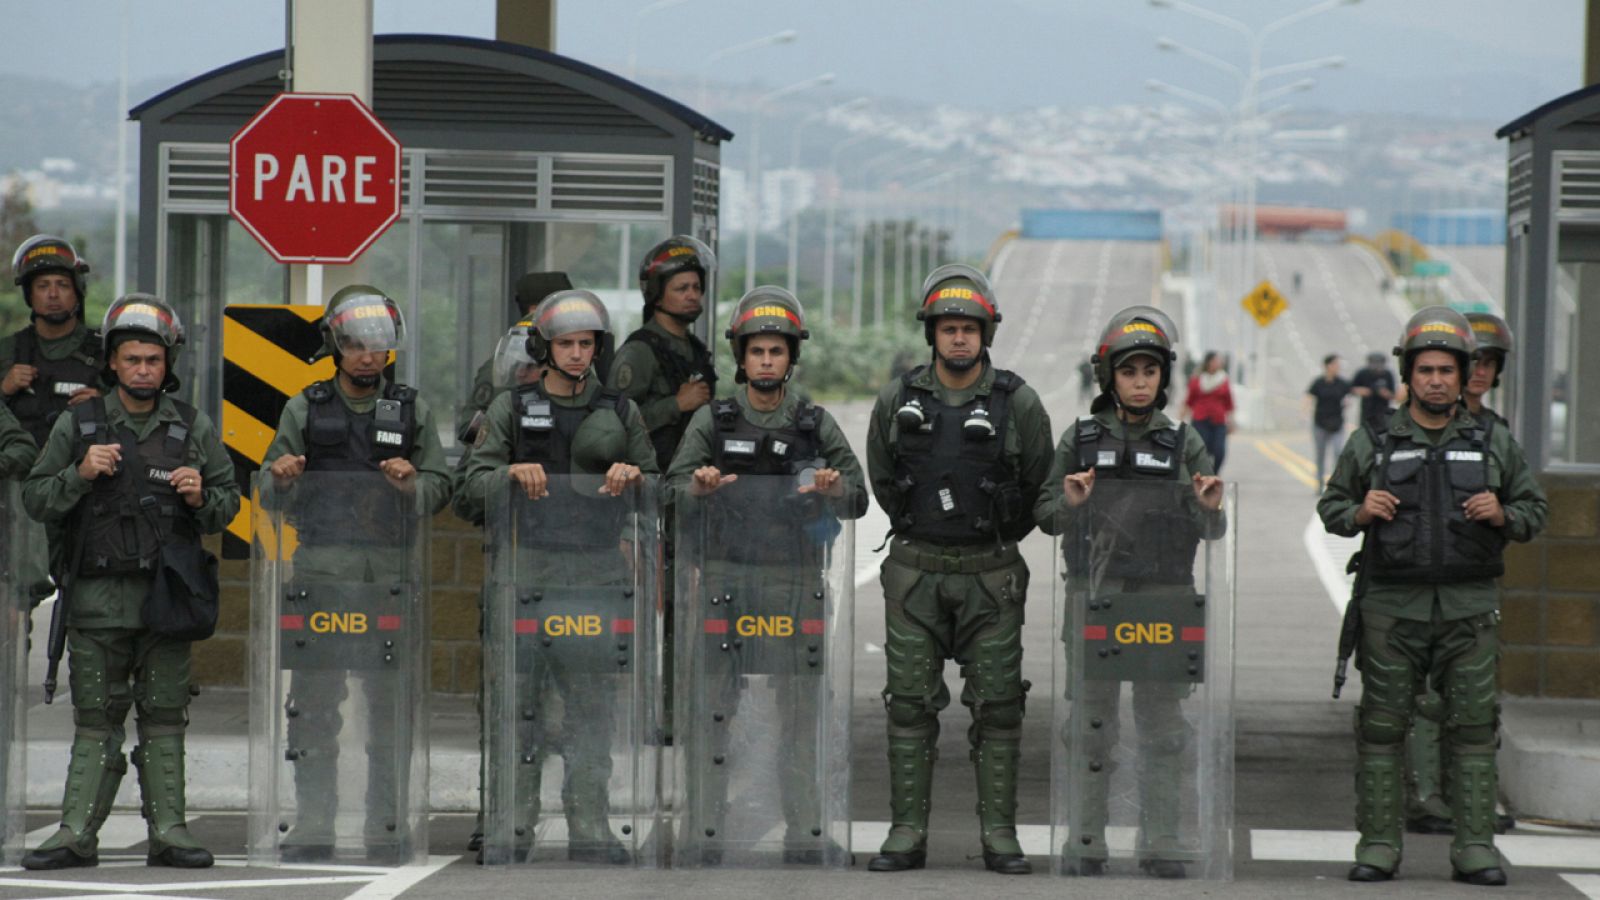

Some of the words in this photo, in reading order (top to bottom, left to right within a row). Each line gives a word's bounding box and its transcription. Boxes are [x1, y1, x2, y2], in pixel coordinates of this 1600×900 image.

[254, 153, 377, 204] PARE
[940, 287, 973, 300] GNB
[353, 304, 386, 319] GNB
[754, 305, 786, 317] GNB
[1123, 323, 1157, 334] GNB
[376, 430, 402, 445] FANB
[1448, 450, 1483, 461] FANB
[309, 611, 368, 634] GNB
[544, 615, 602, 637] GNB
[735, 615, 794, 637] GNB
[1114, 622, 1174, 645] GNB
